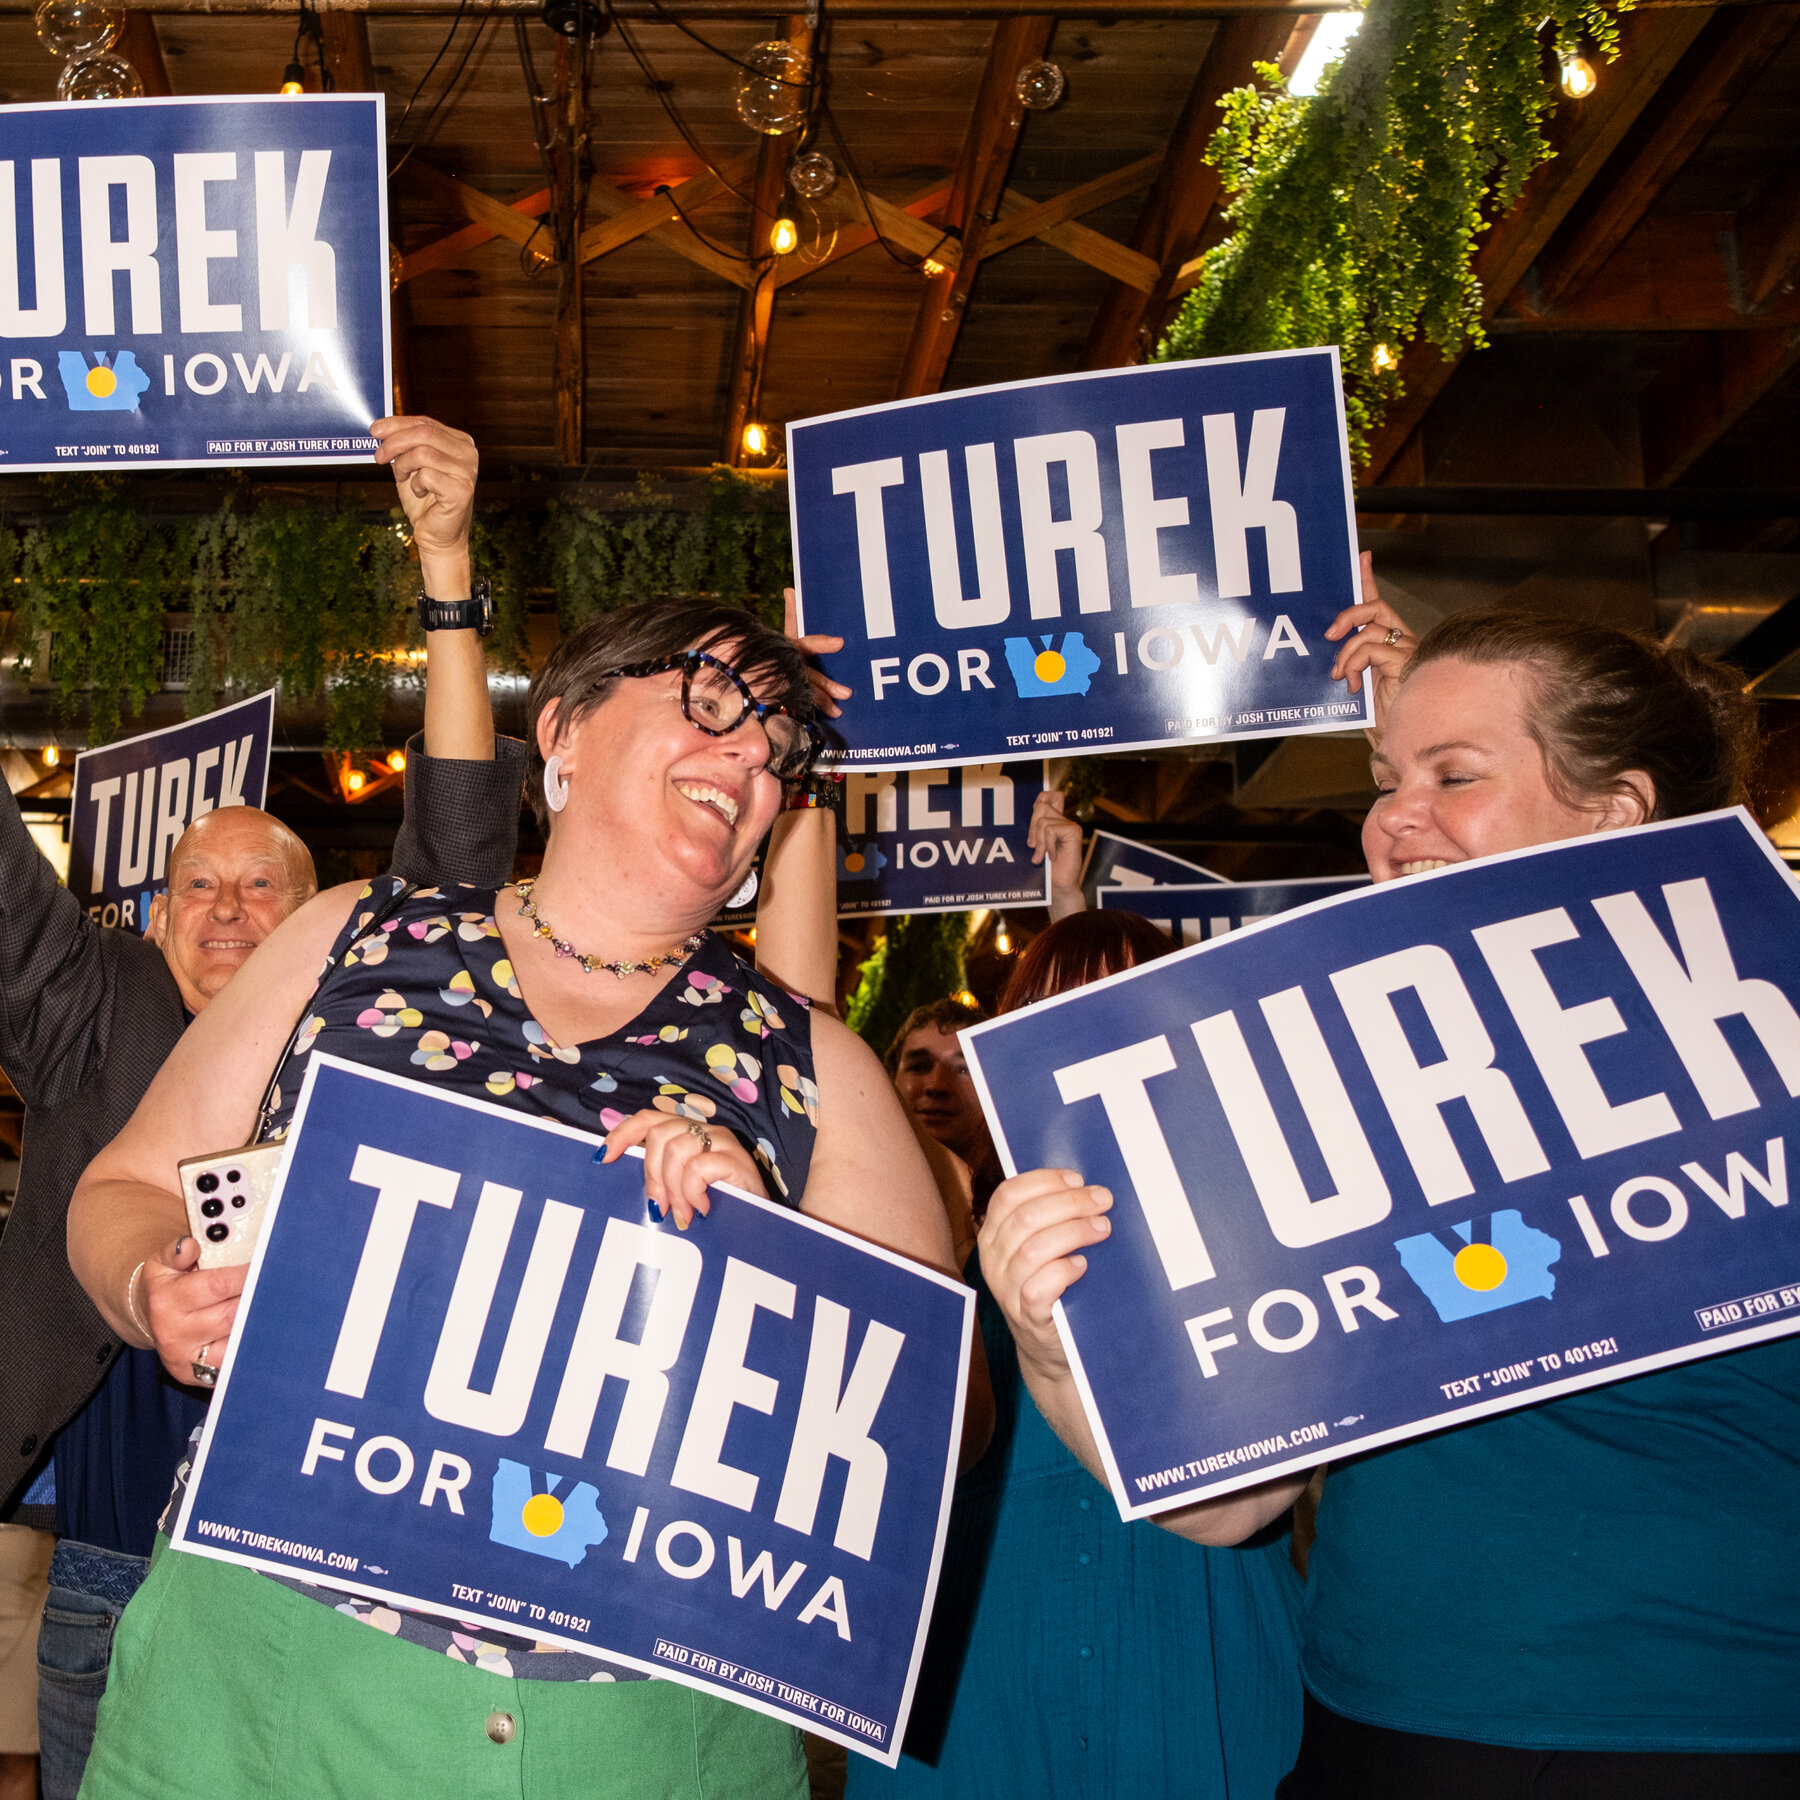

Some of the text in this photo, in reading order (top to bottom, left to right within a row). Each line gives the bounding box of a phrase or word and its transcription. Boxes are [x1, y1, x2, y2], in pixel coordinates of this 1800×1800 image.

[0, 149, 338, 339] UREK
[163, 351, 338, 397] IOWA
[55, 446, 78, 456] TEXT
[113, 445, 126, 455] TO
[128, 443, 159, 455] 40192!
[209, 438, 379, 453] PAID FOR BY JOSH TUREK FOR IOWA
[831, 407, 1303, 639] TUREK
[870, 614, 1309, 700] FOR IOWA
[1006, 734, 1030, 746] TEXT
[1065, 730, 1079, 741] TO
[1081, 726, 1114, 739] 40192!
[1236, 712, 1264, 725] JOSH
[1266, 708, 1301, 722] TUREK
[1304, 706, 1325, 718] FOR
[1327, 703, 1358, 716] IOWA
[846, 763, 1014, 834] REK
[896, 837, 1015, 870] IOWA
[89, 899, 135, 928] FOR
[924, 895, 940, 904] PAID
[942, 895, 955, 903] FOR
[966, 893, 984, 901] JOSH
[985, 892, 1007, 900] TUREK
[1008, 891, 1021, 899] FOR
[1022, 890, 1041, 898] IOWA
[1052, 877, 1800, 1292] TUREK
[1183, 1136, 1789, 1379] FOR IOW
[1700, 1303, 1742, 1328] PAID
[1743, 1293, 1780, 1316] FOR
[324, 1144, 906, 1561] TUREK
[1440, 1375, 1482, 1400] TEXT
[1537, 1353, 1562, 1372] TO
[1564, 1337, 1619, 1365] 40192!
[1135, 1421, 1329, 1493] WWW.TUREK4IOWA.COM
[197, 1519, 359, 1572] WWW.TUREK4IOWA.COM
[300, 1418, 853, 1642] FOR IOWA
[452, 1584, 484, 1603] TEXT
[529, 1603, 546, 1620] TO
[548, 1610, 591, 1633] 40192!
[656, 1641, 883, 1741] PAID FOR BY JOSH TUREK FOR IOWA
